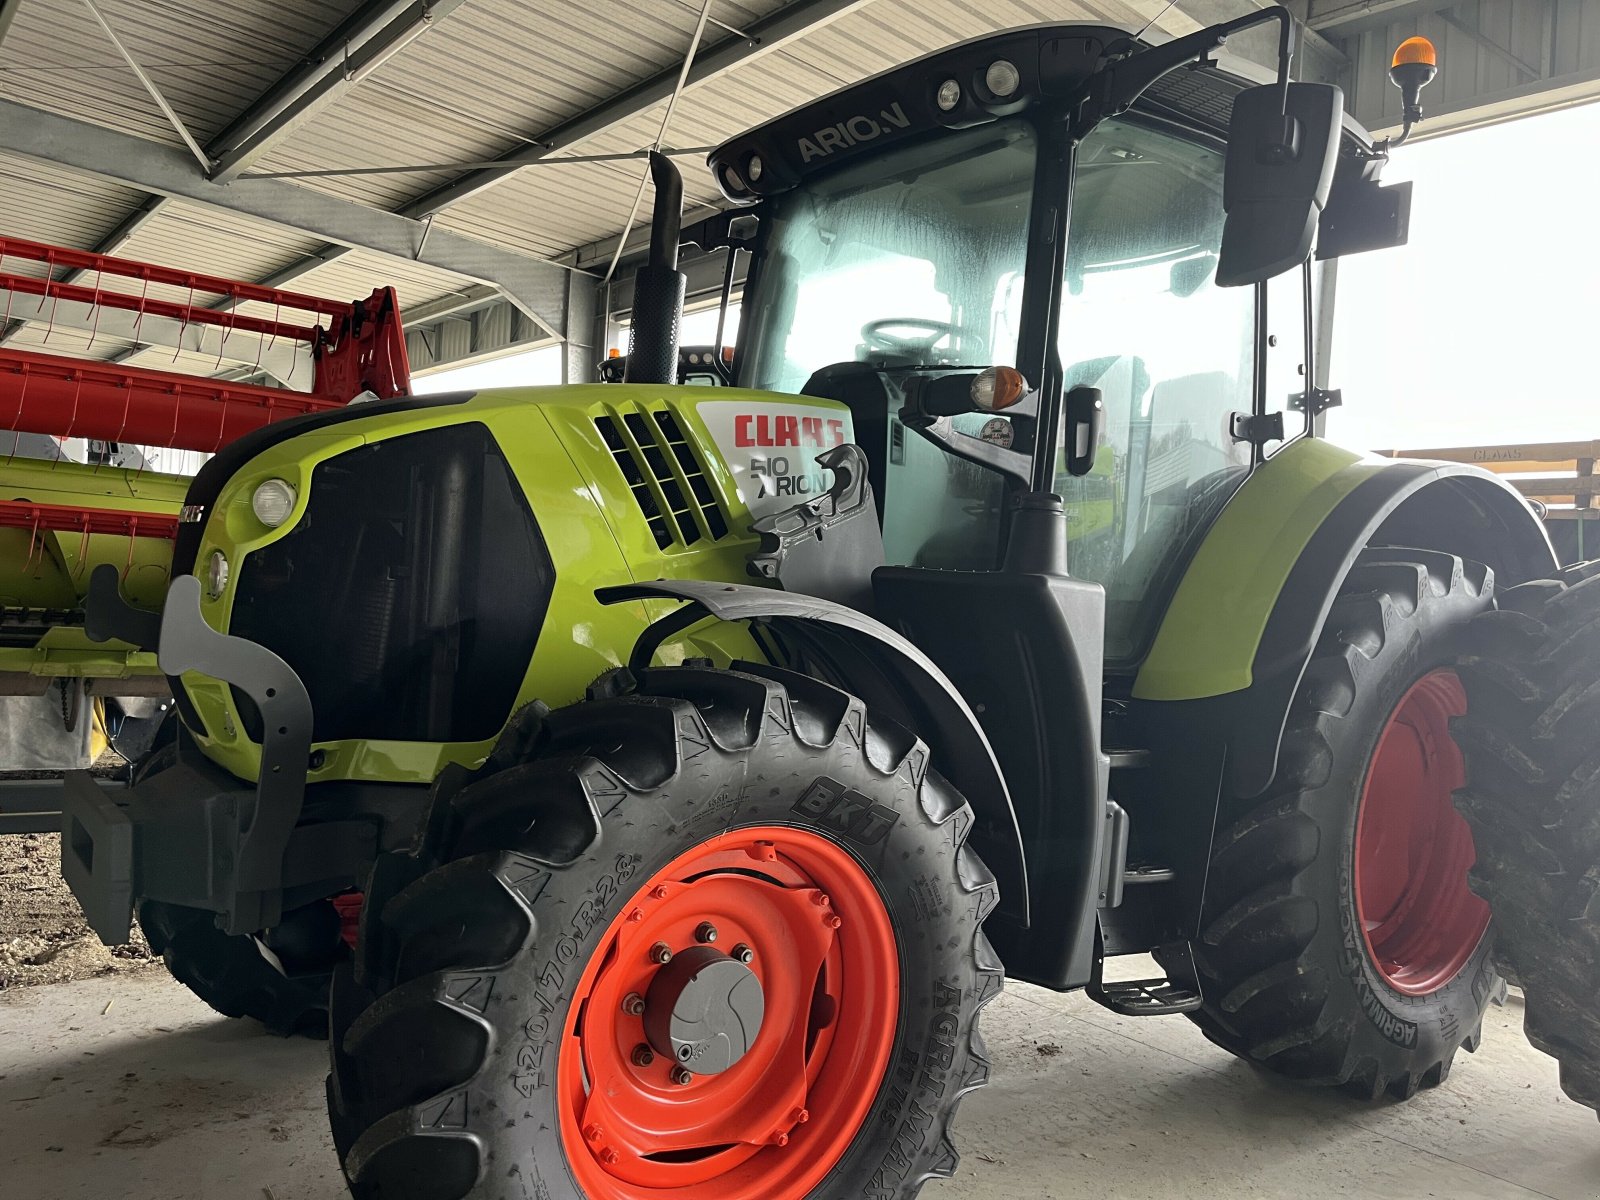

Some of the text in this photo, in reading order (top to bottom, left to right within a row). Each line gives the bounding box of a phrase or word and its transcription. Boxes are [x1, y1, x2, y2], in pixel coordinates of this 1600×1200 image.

[797, 102, 911, 163] ARION
[735, 415, 844, 447] CLAAS
[751, 457, 789, 478] 510
[1473, 449, 1522, 461] CLAAS
[792, 777, 899, 844] BKT
[1351, 969, 1416, 1046] AGRIMAX
